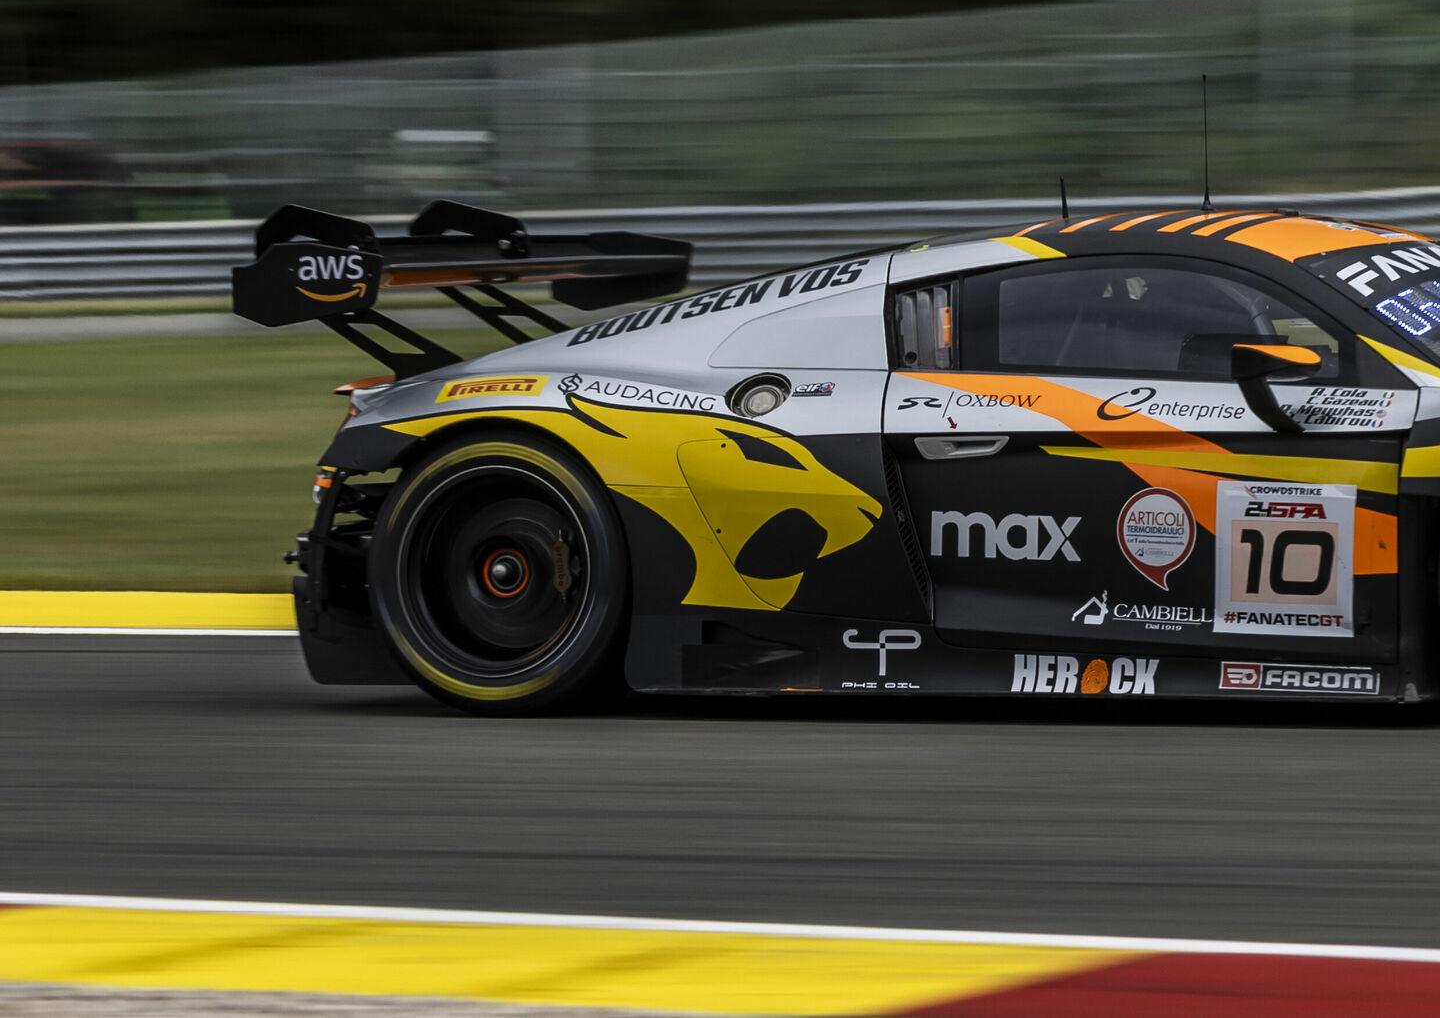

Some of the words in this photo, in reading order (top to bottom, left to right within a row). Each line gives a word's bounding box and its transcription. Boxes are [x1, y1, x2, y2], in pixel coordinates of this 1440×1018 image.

[298, 254, 364, 281] aws
[566, 279, 775, 347] BOUTSEN
[447, 379, 537, 397] PIRELLI
[584, 381, 716, 411] AUDACING
[796, 383, 820, 392] elf
[1330, 388, 1368, 398] Cola
[956, 394, 1041, 408] OXBOW
[1148, 397, 1245, 420] enterprise
[1321, 397, 1379, 407] Gazeau
[1250, 486, 1323, 496] CROWDSTRIKE
[1127, 511, 1185, 527] ARTICOLI
[930, 510, 1082, 562] max
[1240, 529, 1335, 595] 10
[1113, 603, 1213, 622] CAMBIELL
[1224, 611, 1344, 627] #FANATECGT
[1265, 670, 1374, 690] FACOM
